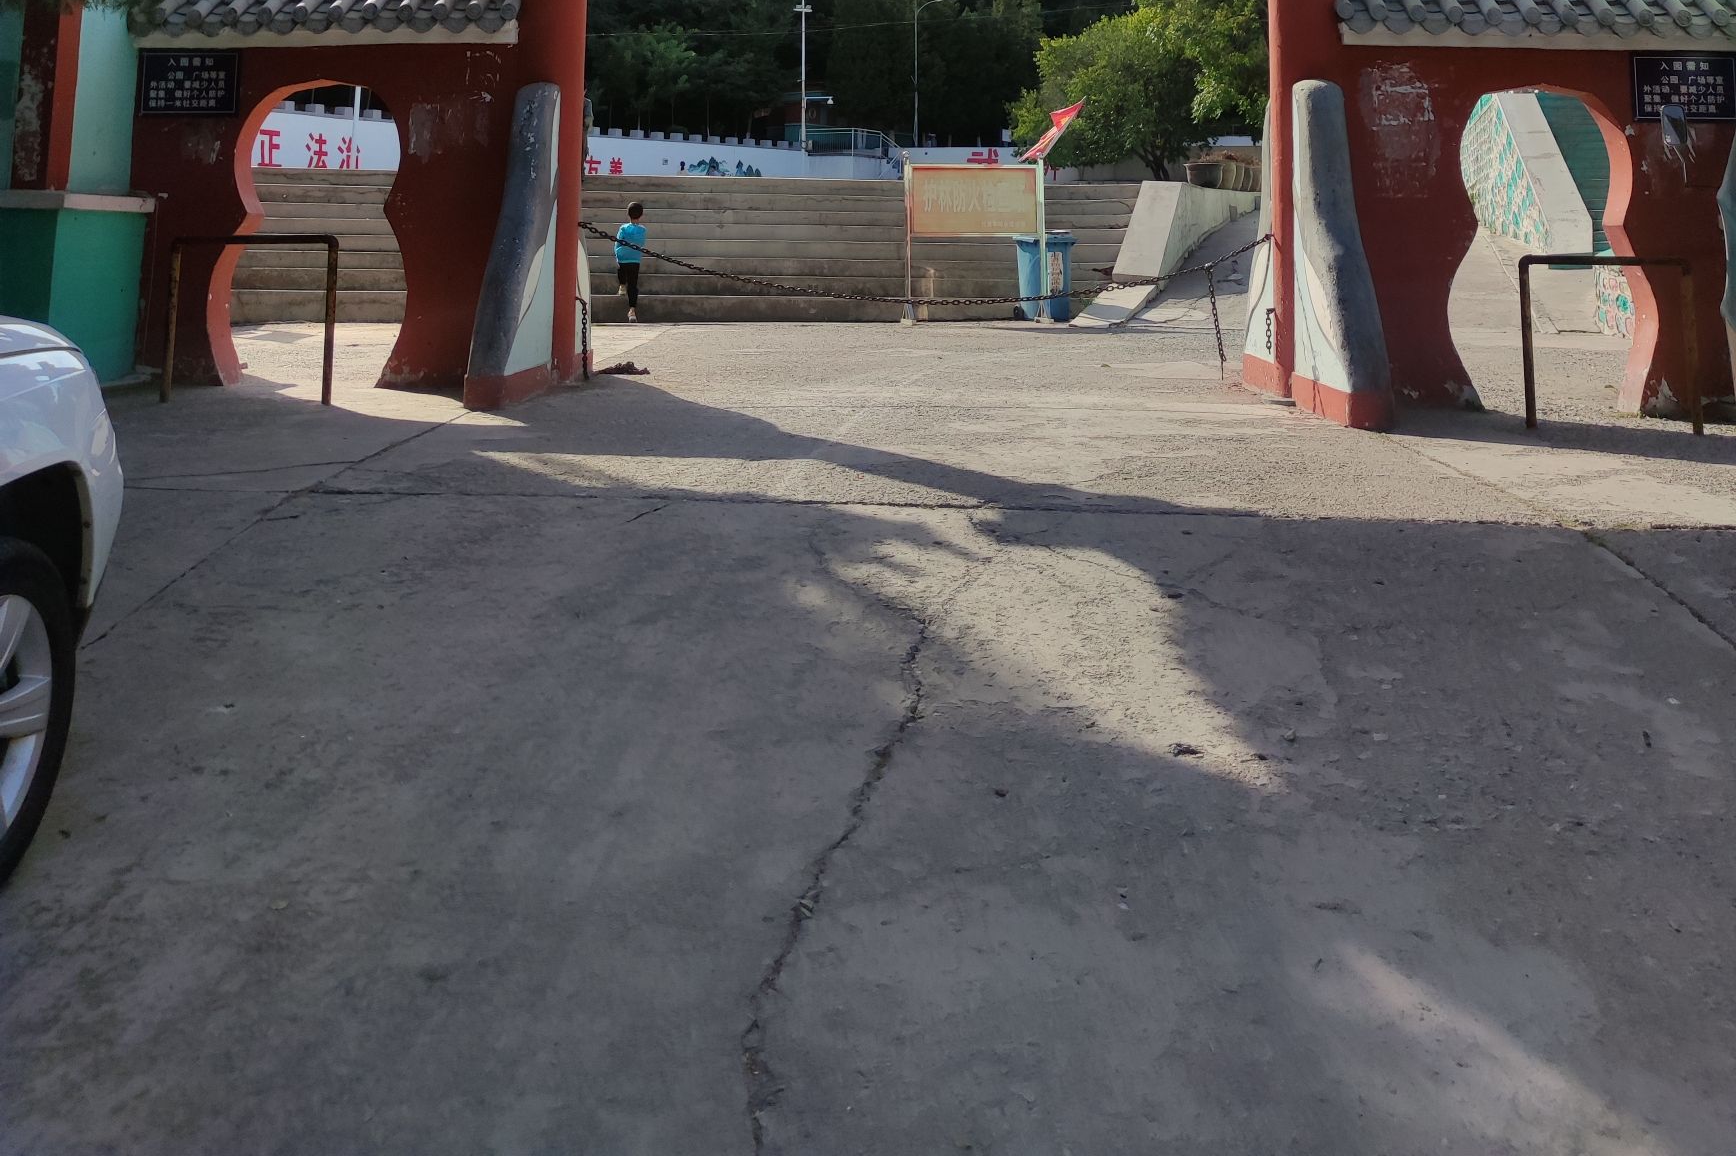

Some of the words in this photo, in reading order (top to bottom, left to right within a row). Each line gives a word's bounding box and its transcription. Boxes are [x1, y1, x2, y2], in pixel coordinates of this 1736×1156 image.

[1660, 61, 1709, 71] 入园需知
[258, 129, 282, 167] 正
